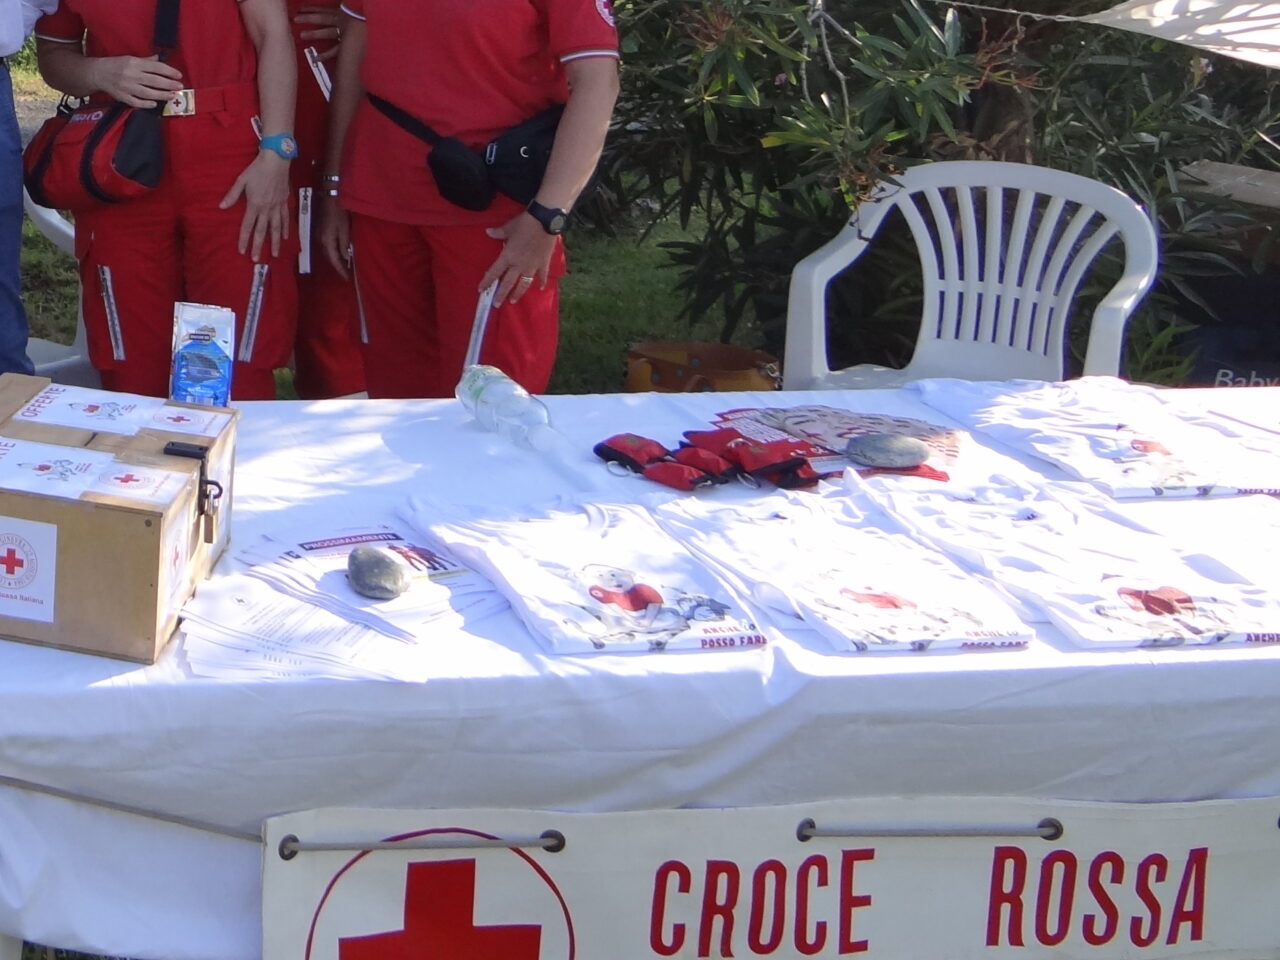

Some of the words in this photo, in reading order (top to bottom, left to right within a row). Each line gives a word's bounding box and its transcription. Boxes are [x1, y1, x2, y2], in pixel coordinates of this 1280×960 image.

[21, 387, 66, 417] OFFERTE
[701, 637, 735, 648] POSSO
[649, 848, 876, 958] CROCE
[986, 846, 1209, 947] ROSSA
